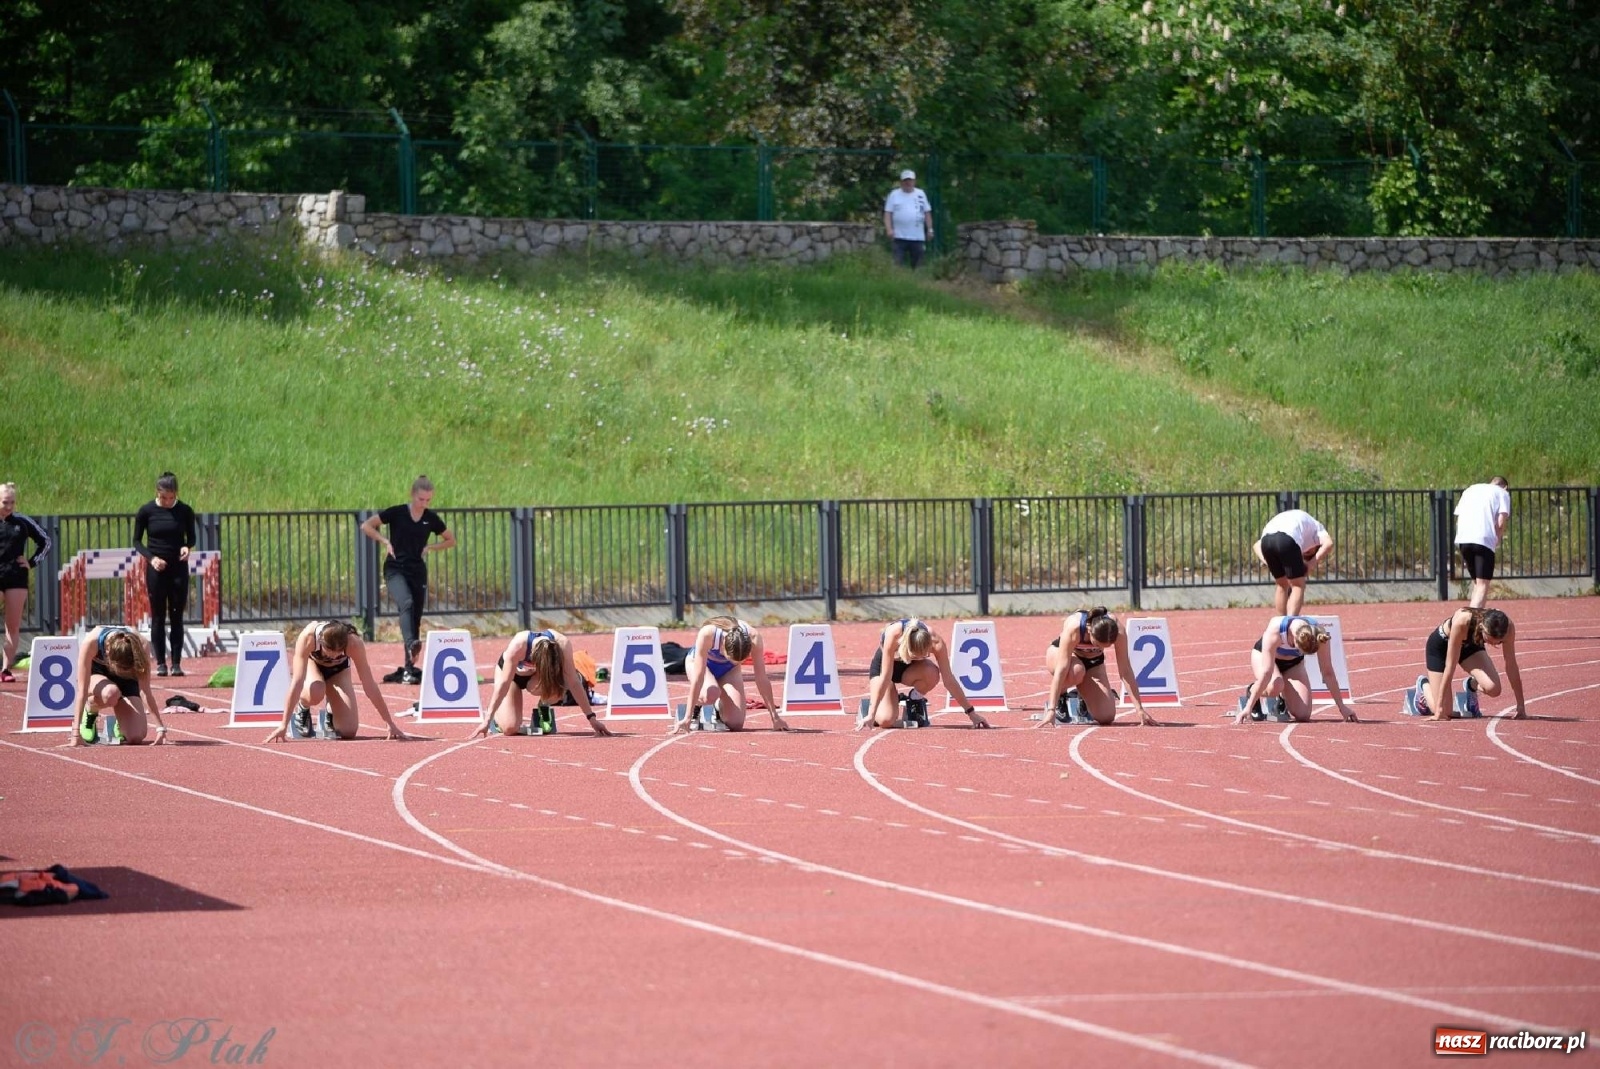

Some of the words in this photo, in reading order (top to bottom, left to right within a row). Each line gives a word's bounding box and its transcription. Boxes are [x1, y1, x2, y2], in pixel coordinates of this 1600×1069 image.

[40, 655, 76, 710] 8
[244, 649, 281, 706] 7
[432, 648, 469, 702] 6
[622, 644, 657, 699] 5
[794, 641, 831, 696] 4
[959, 638, 993, 691] 3
[1133, 634, 1168, 688] 2
